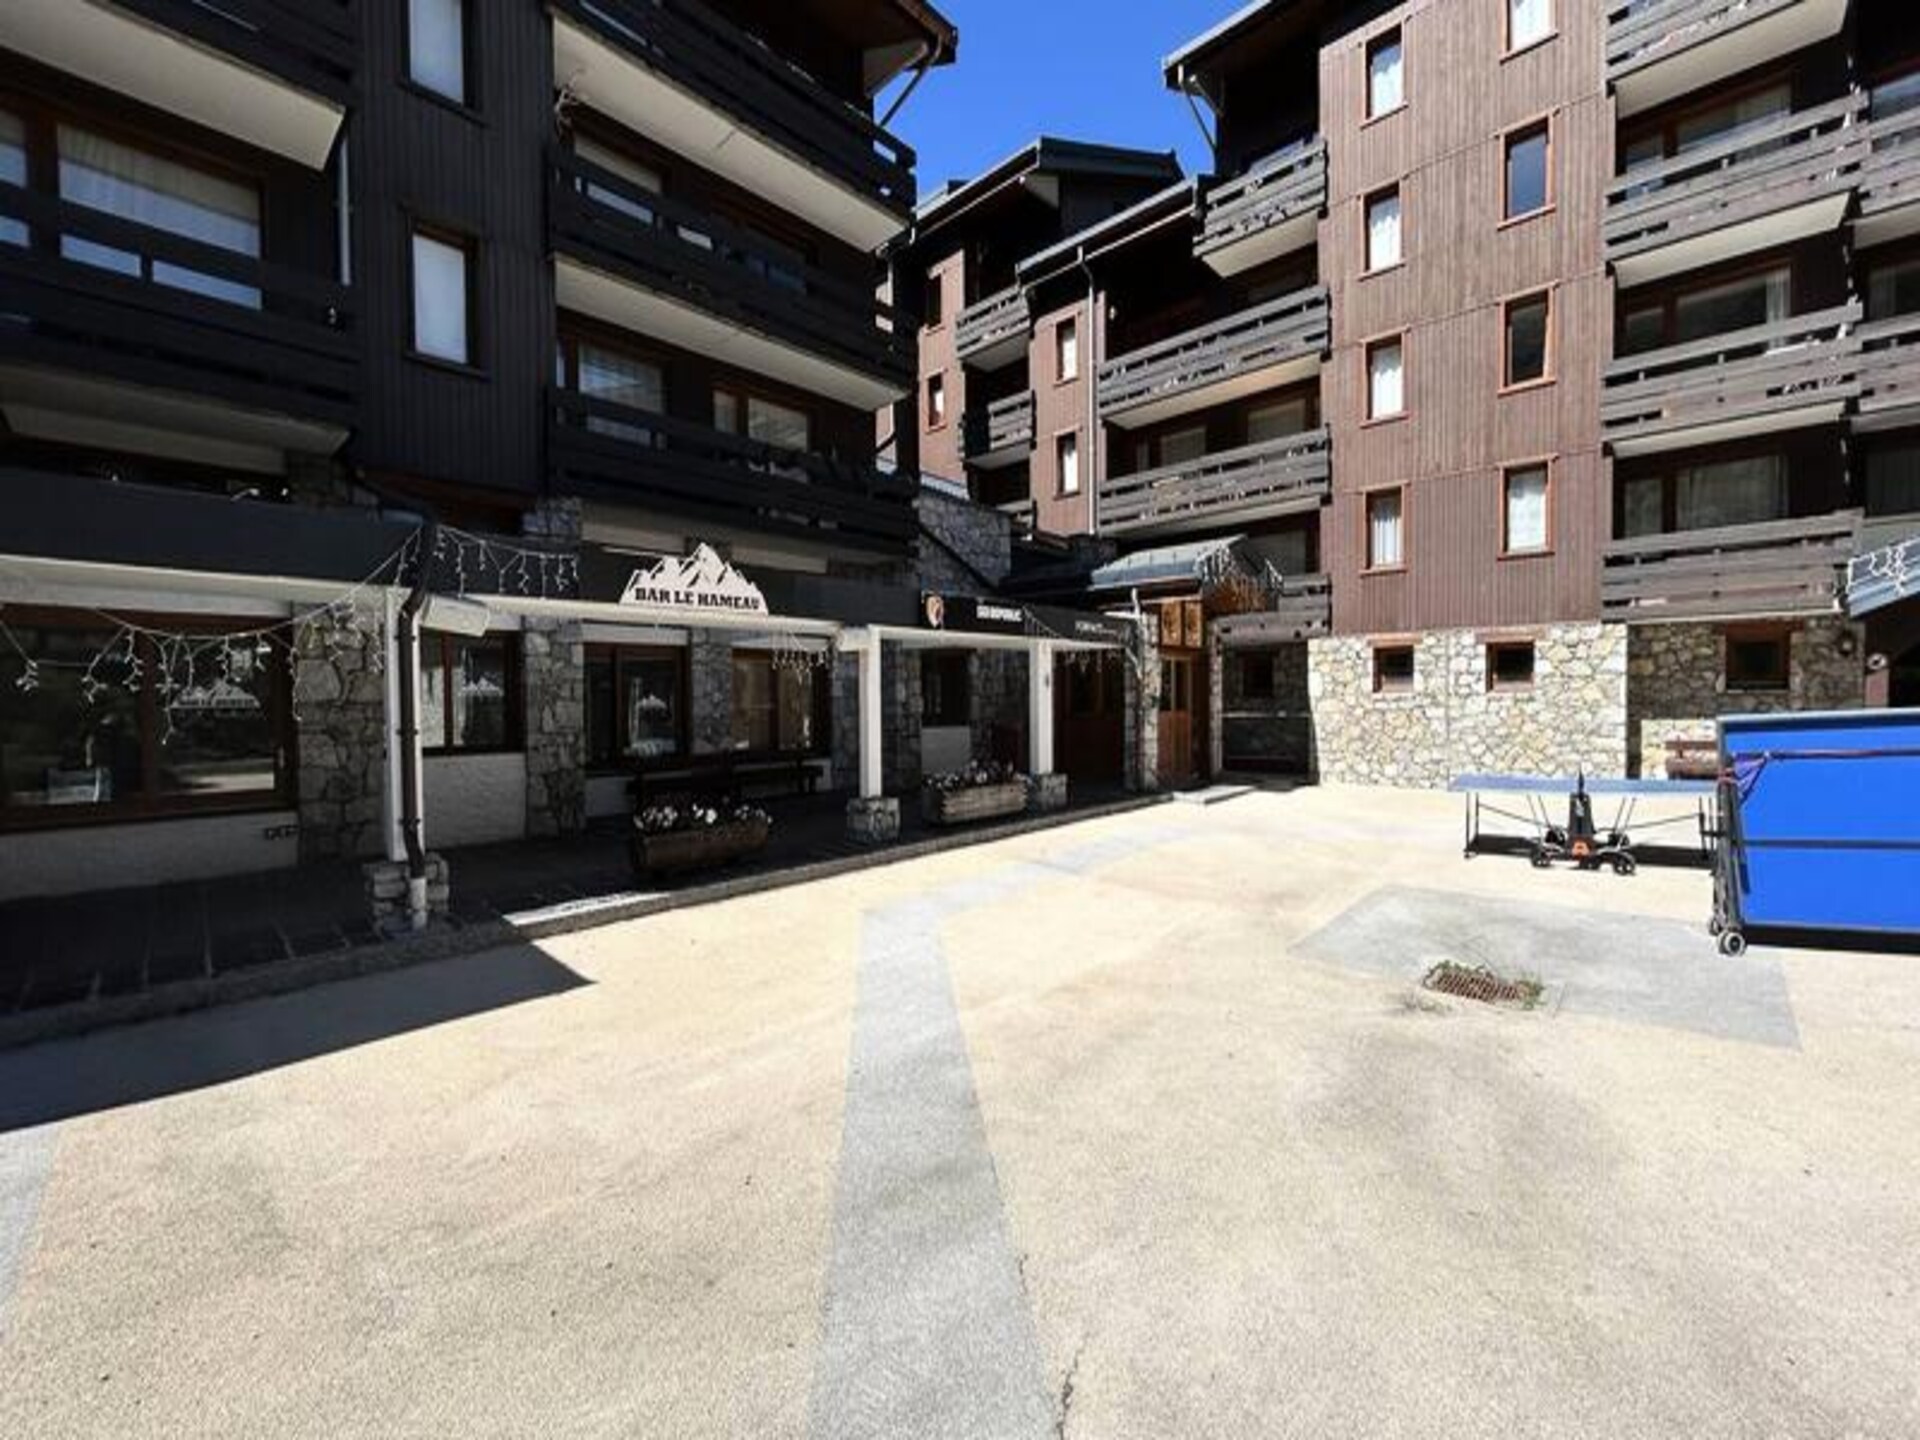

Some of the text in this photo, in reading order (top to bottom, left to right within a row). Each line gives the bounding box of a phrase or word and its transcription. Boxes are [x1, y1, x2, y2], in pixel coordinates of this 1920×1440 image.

[635, 587, 760, 610] BAR LE HAMEAU
